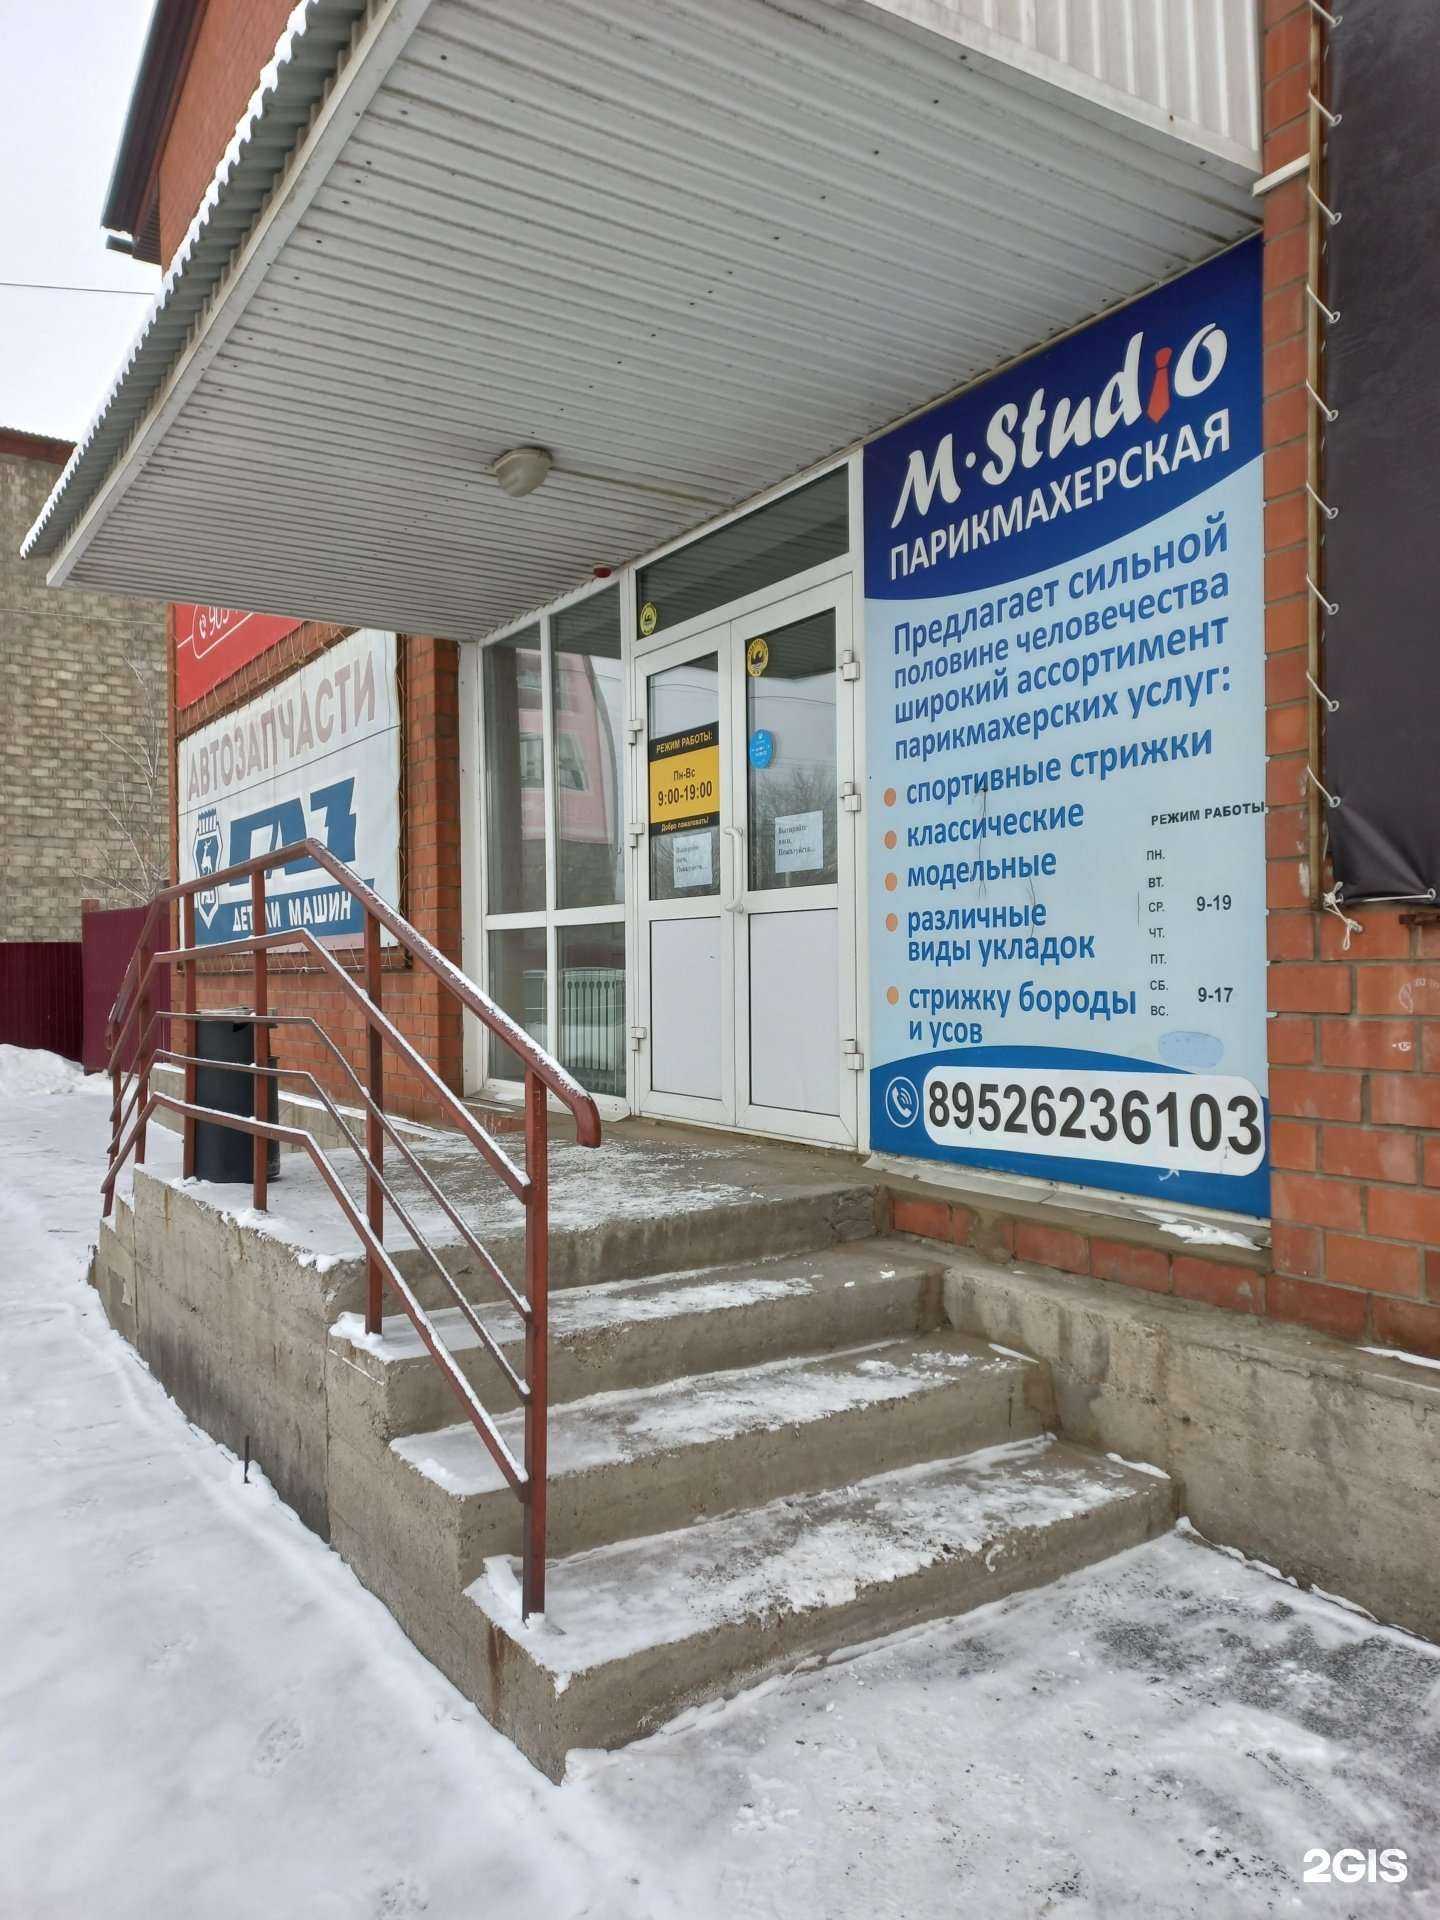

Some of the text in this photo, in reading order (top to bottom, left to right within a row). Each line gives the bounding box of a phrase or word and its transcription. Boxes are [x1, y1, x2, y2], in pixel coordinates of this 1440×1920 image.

[890, 408, 1231, 581] ПАРИКМАХЕРСКАЯ
[894, 510, 1229, 656] Предлагает сильной
[894, 572, 1229, 688] половине человечества
[895, 616, 1229, 723] широкий ассортимент
[188, 650, 376, 801] АВТОЗАПЧАСТИ
[895, 663, 1231, 761] парикмахерских услуг:
[656, 731, 713, 753] РЕЖИМ РАБОТЫ:
[673, 767, 696, 781] Пн-Вс
[907, 728, 1213, 806] спортивные стрижки
[658, 780, 713, 807] 9:00-19:00
[907, 803, 1084, 847] классические
[1151, 801, 1265, 826] РЕЖИМ РАБОТЫ
[229, 776, 357, 887] ГАЗ
[907, 852, 1057, 890] модельные
[1147, 850, 1165, 861] ПН.
[1148, 877, 1164, 888] ВТ.
[232, 890, 352, 932] ДЕТЛИ МАШИН
[907, 903, 1047, 937] различные
[1148, 894, 1232, 913] СР. 9-19
[1149, 927, 1165, 938] ЧТ.
[908, 935, 1095, 967] виды укладок
[1150, 954, 1167, 965] ПТ.
[908, 980, 1137, 1020] стрижку бороды
[1150, 980, 1234, 1003] СБ. 9-17
[1150, 1005, 1169, 1017] ВС.
[908, 1019, 983, 1048] и усов
[928, 1079, 1262, 1156] 89526236103
